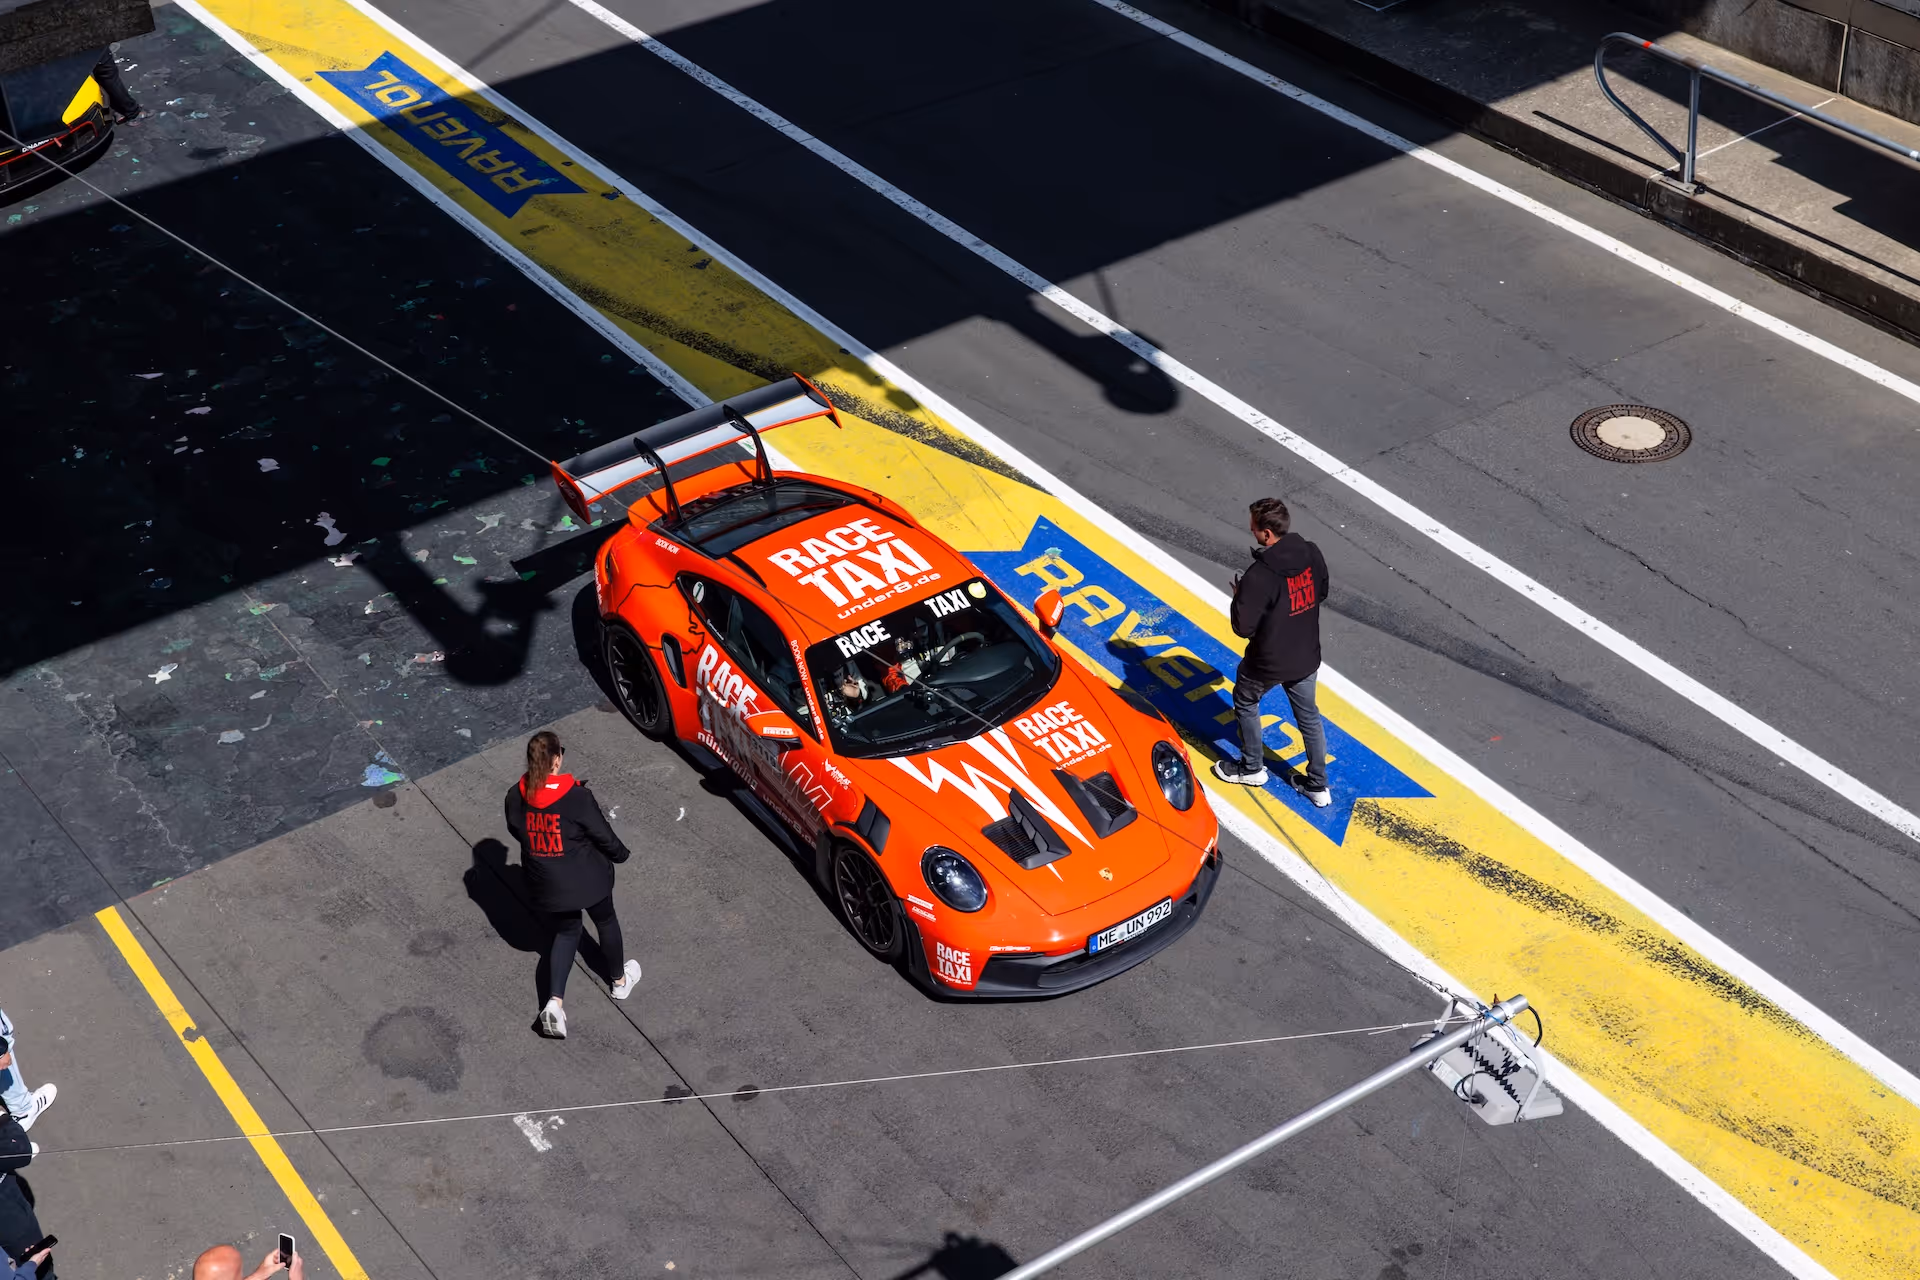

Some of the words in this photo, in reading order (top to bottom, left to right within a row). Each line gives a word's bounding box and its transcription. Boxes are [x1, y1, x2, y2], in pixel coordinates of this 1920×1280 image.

[364, 69, 540, 194] RAVENOL
[767, 518, 895, 577] RACE
[797, 538, 933, 607] TAXI
[1286, 567, 1313, 595] RACE
[837, 572, 941, 619] under8.de
[1289, 580, 1315, 611] TAXI
[835, 620, 891, 658] RACE
[923, 588, 972, 618] TAXI
[697, 644, 758, 722] RACE
[791, 640, 803, 661] BOOK
[798, 661, 809, 680] NOW
[805, 687, 825, 740] under8.de
[1013, 700, 1084, 740] RACE
[1033, 720, 1107, 763] TAXI
[1056, 743, 1112, 770] under8.de
[526, 811, 561, 833] RACE
[528, 832, 564, 853] TAXI
[1099, 929, 1117, 948] ME
[1126, 916, 1144, 934] UN
[1147, 902, 1170, 924] 992
[937, 942, 970, 966] RACE
[937, 956, 972, 981] TAXI
